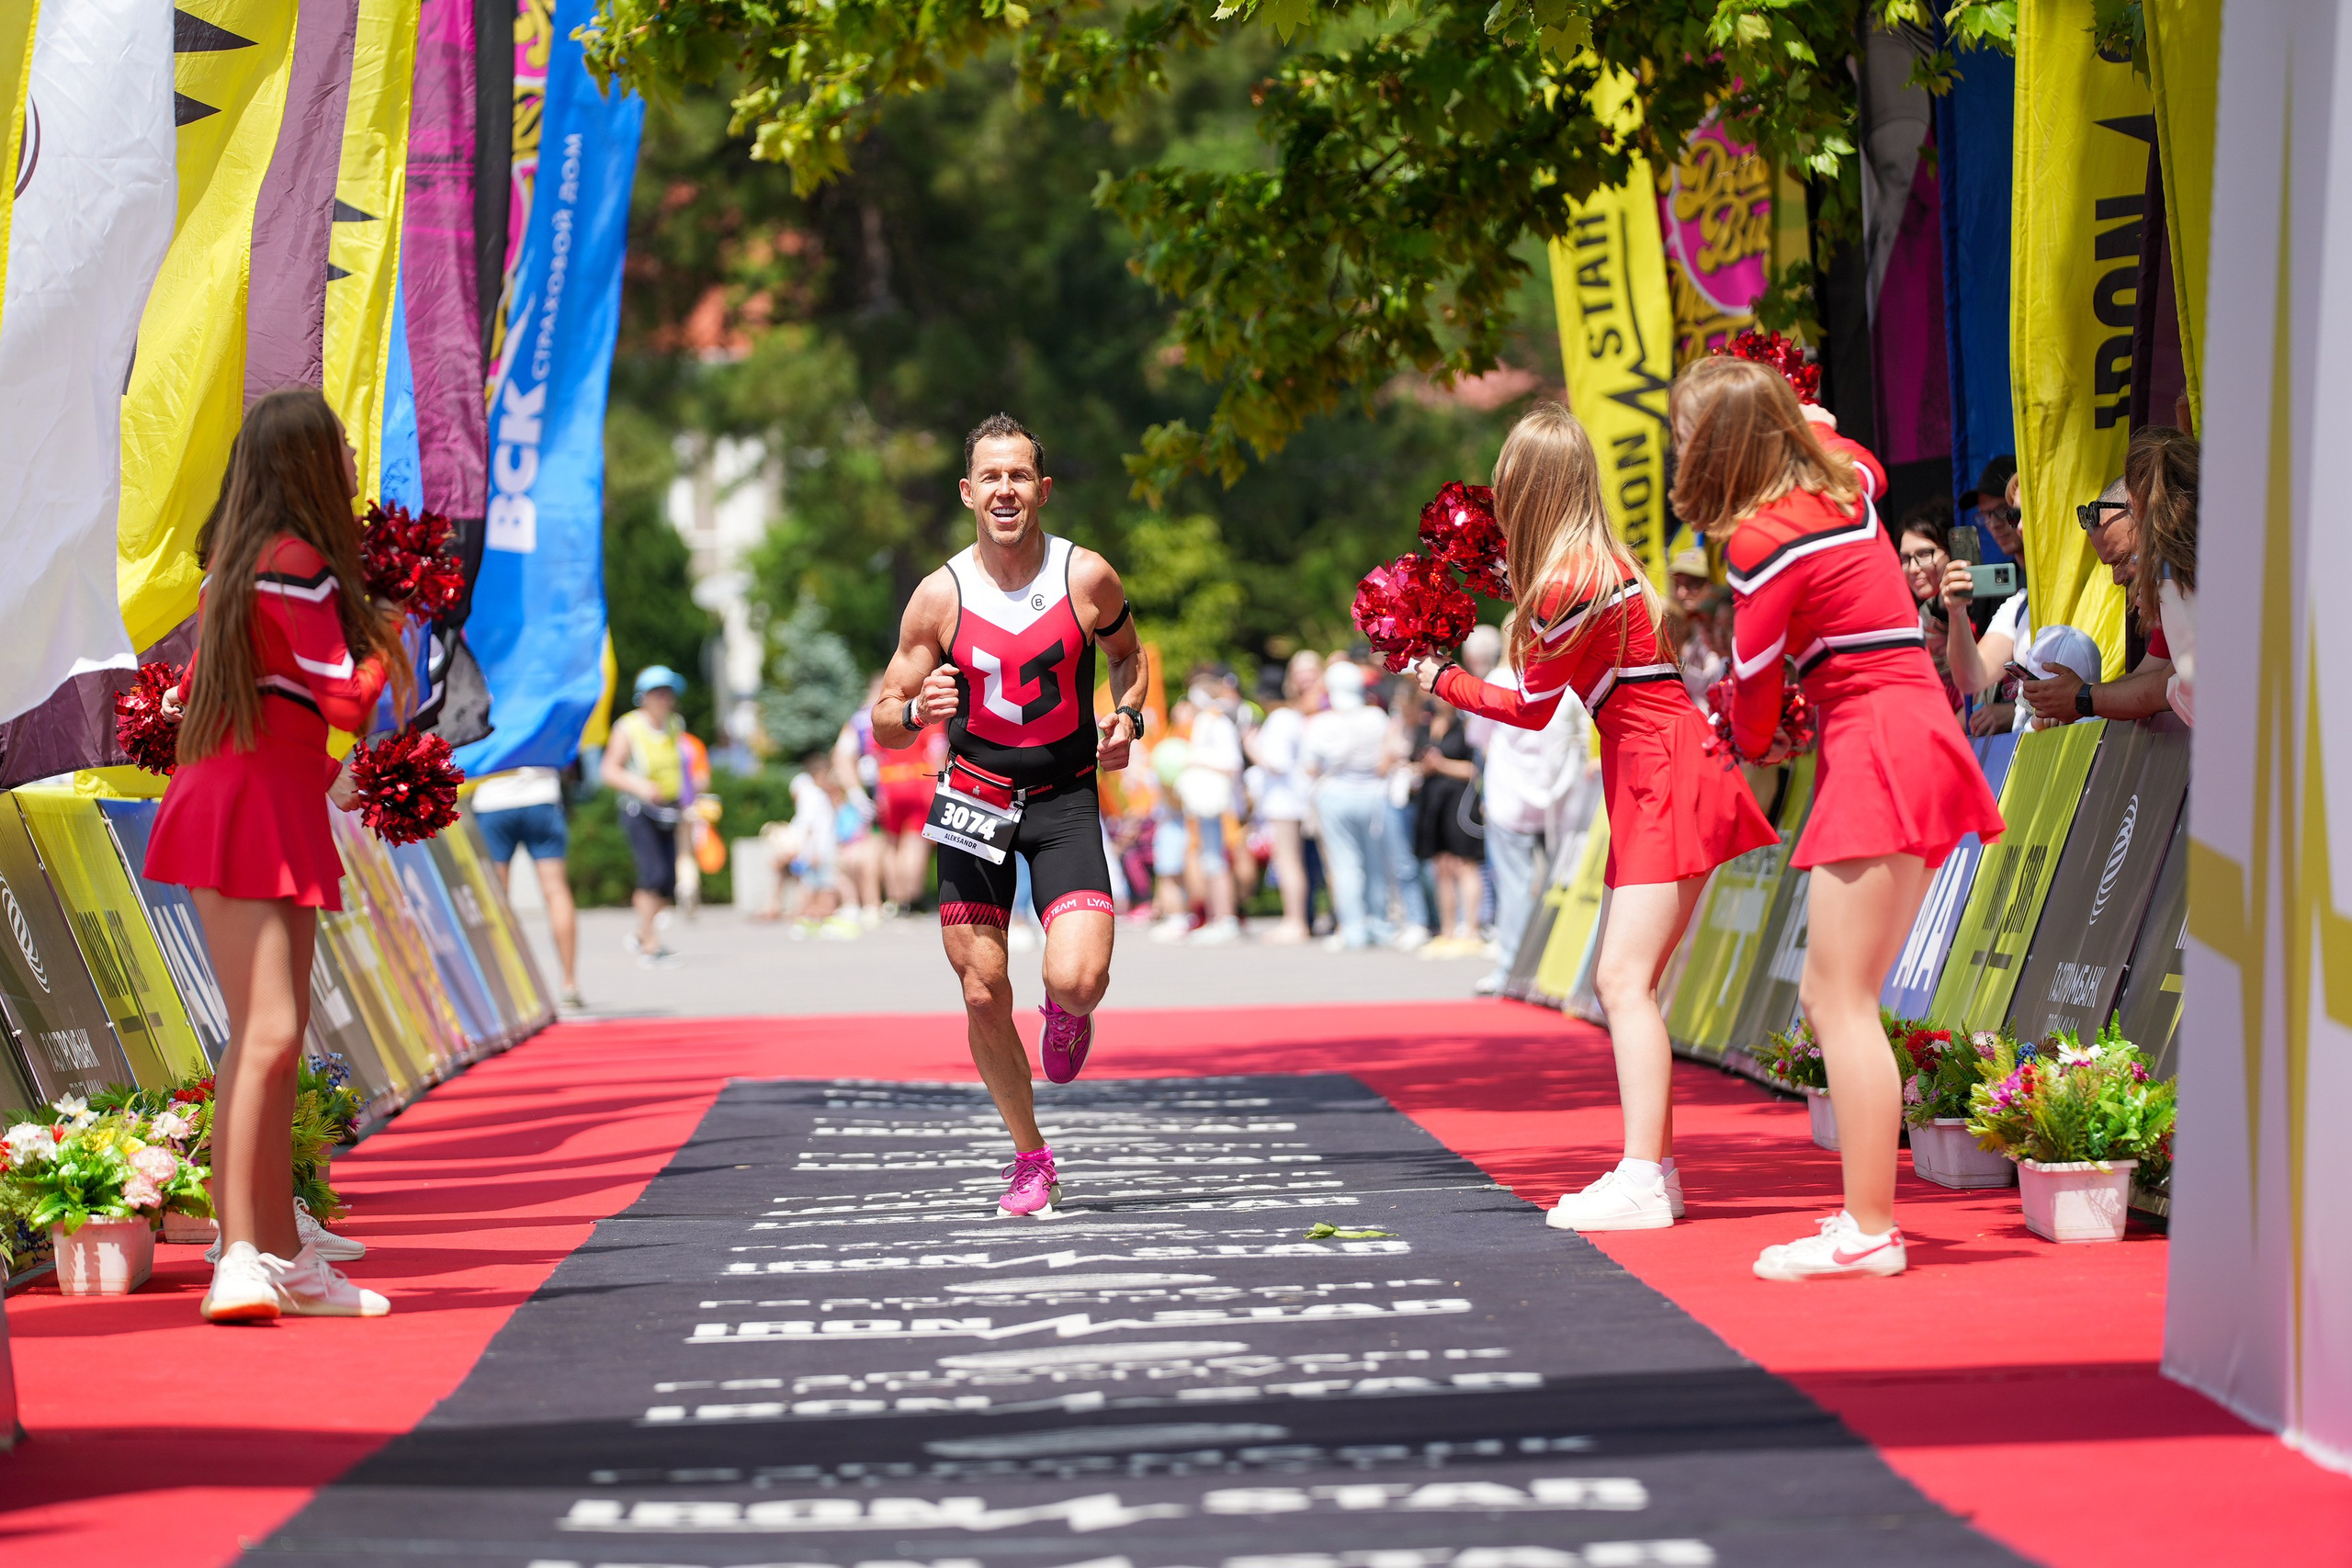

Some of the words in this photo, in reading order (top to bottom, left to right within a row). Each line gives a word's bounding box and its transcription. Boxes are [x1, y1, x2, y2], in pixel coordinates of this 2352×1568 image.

[532, 208, 574, 381] СТРАХОВОЙ
[558, 133, 583, 205] ДОМ
[486, 377, 548, 553] ВСК
[1612, 433, 1651, 564] RON
[940, 802, 998, 840] 3074
[944, 832, 978, 850] ALEKSANDR
[1051, 898, 1077, 917] TEAM
[2047, 961, 2107, 1008] ГАЗПРОМБАНК
[40, 1028, 100, 1073] ГАЗПРОМБАНК
[729, 1252, 990, 1272] IRON
[1132, 1240, 1412, 1258] STAR
[694, 1316, 992, 1337] IRON
[1152, 1298, 1473, 1321] STAR
